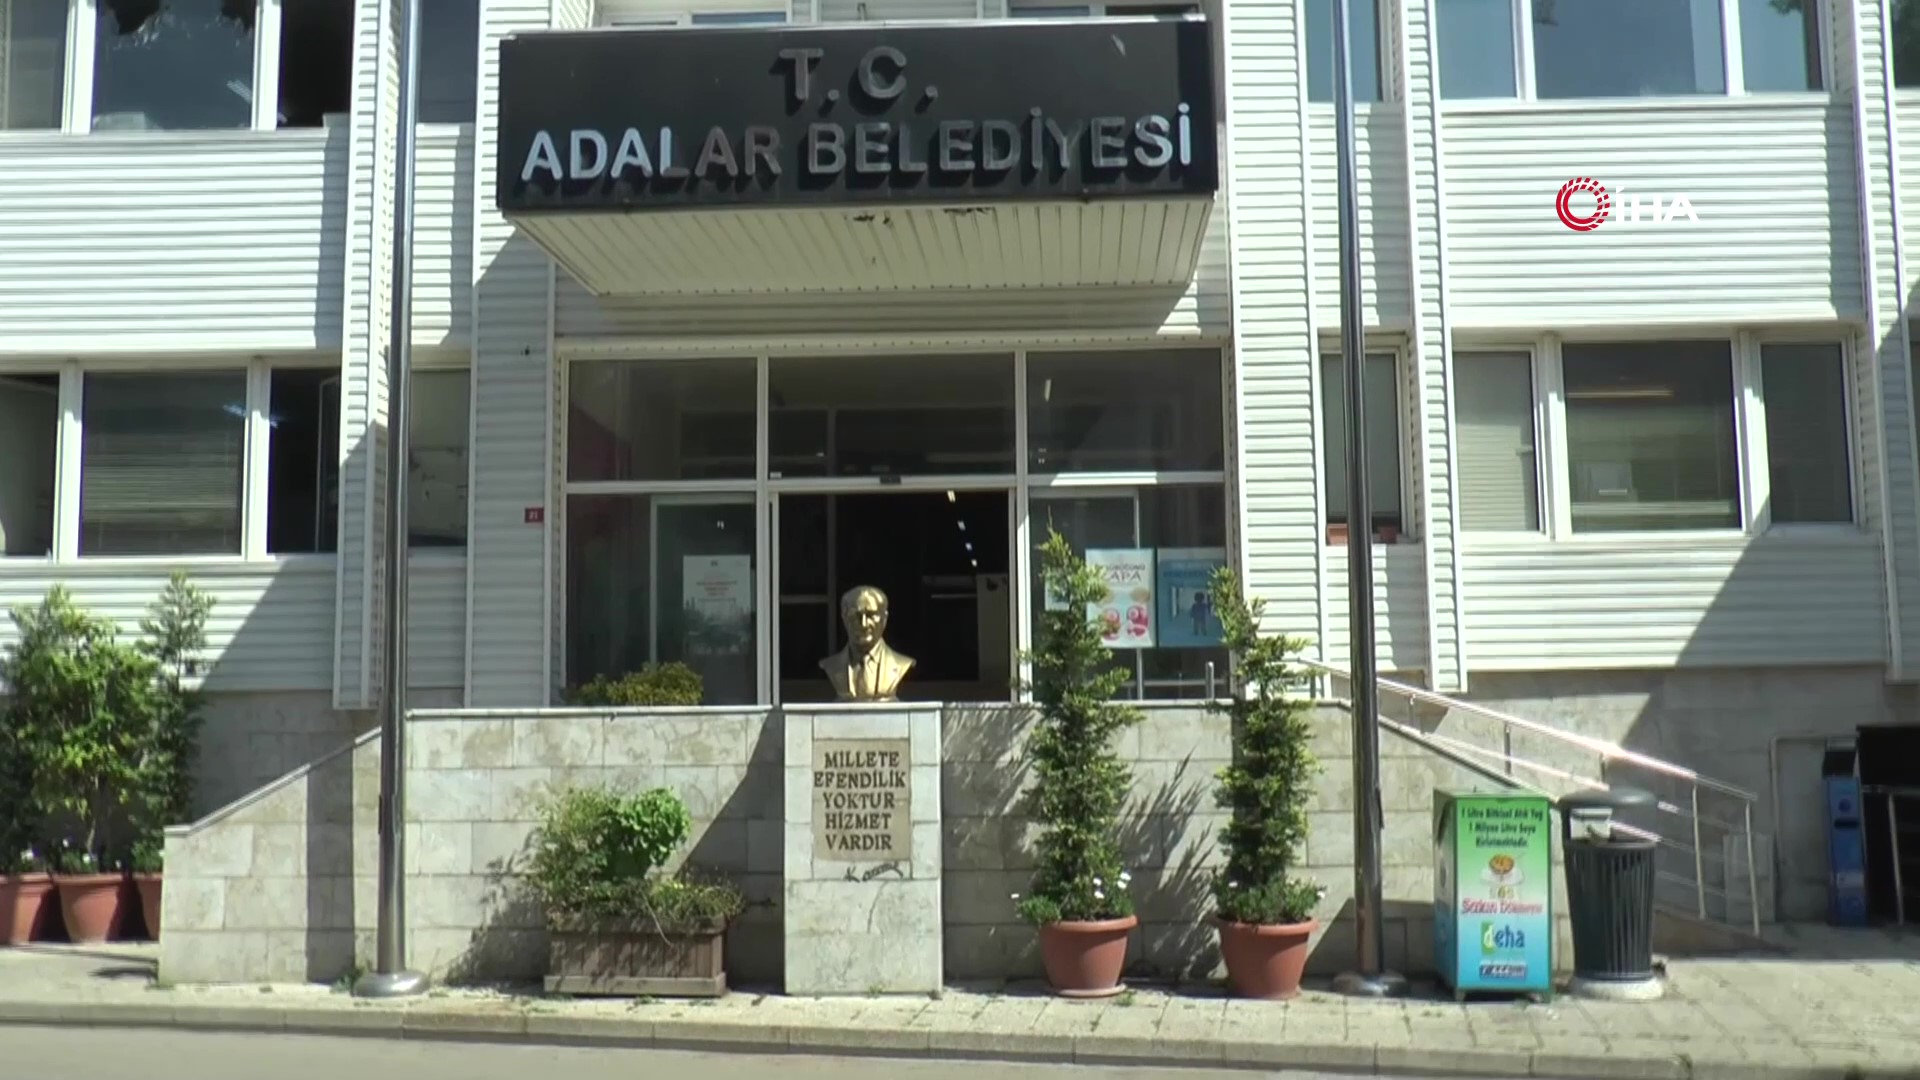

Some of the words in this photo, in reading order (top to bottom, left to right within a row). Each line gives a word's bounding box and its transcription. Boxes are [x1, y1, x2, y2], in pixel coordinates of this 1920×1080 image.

[521, 126, 781, 181] ADALAR
[808, 102, 1191, 174] BELEDİYESİ
[823, 791, 895, 809] YOKTUR
[825, 834, 892, 851] VARDIR
[1483, 924, 1526, 949] deha
